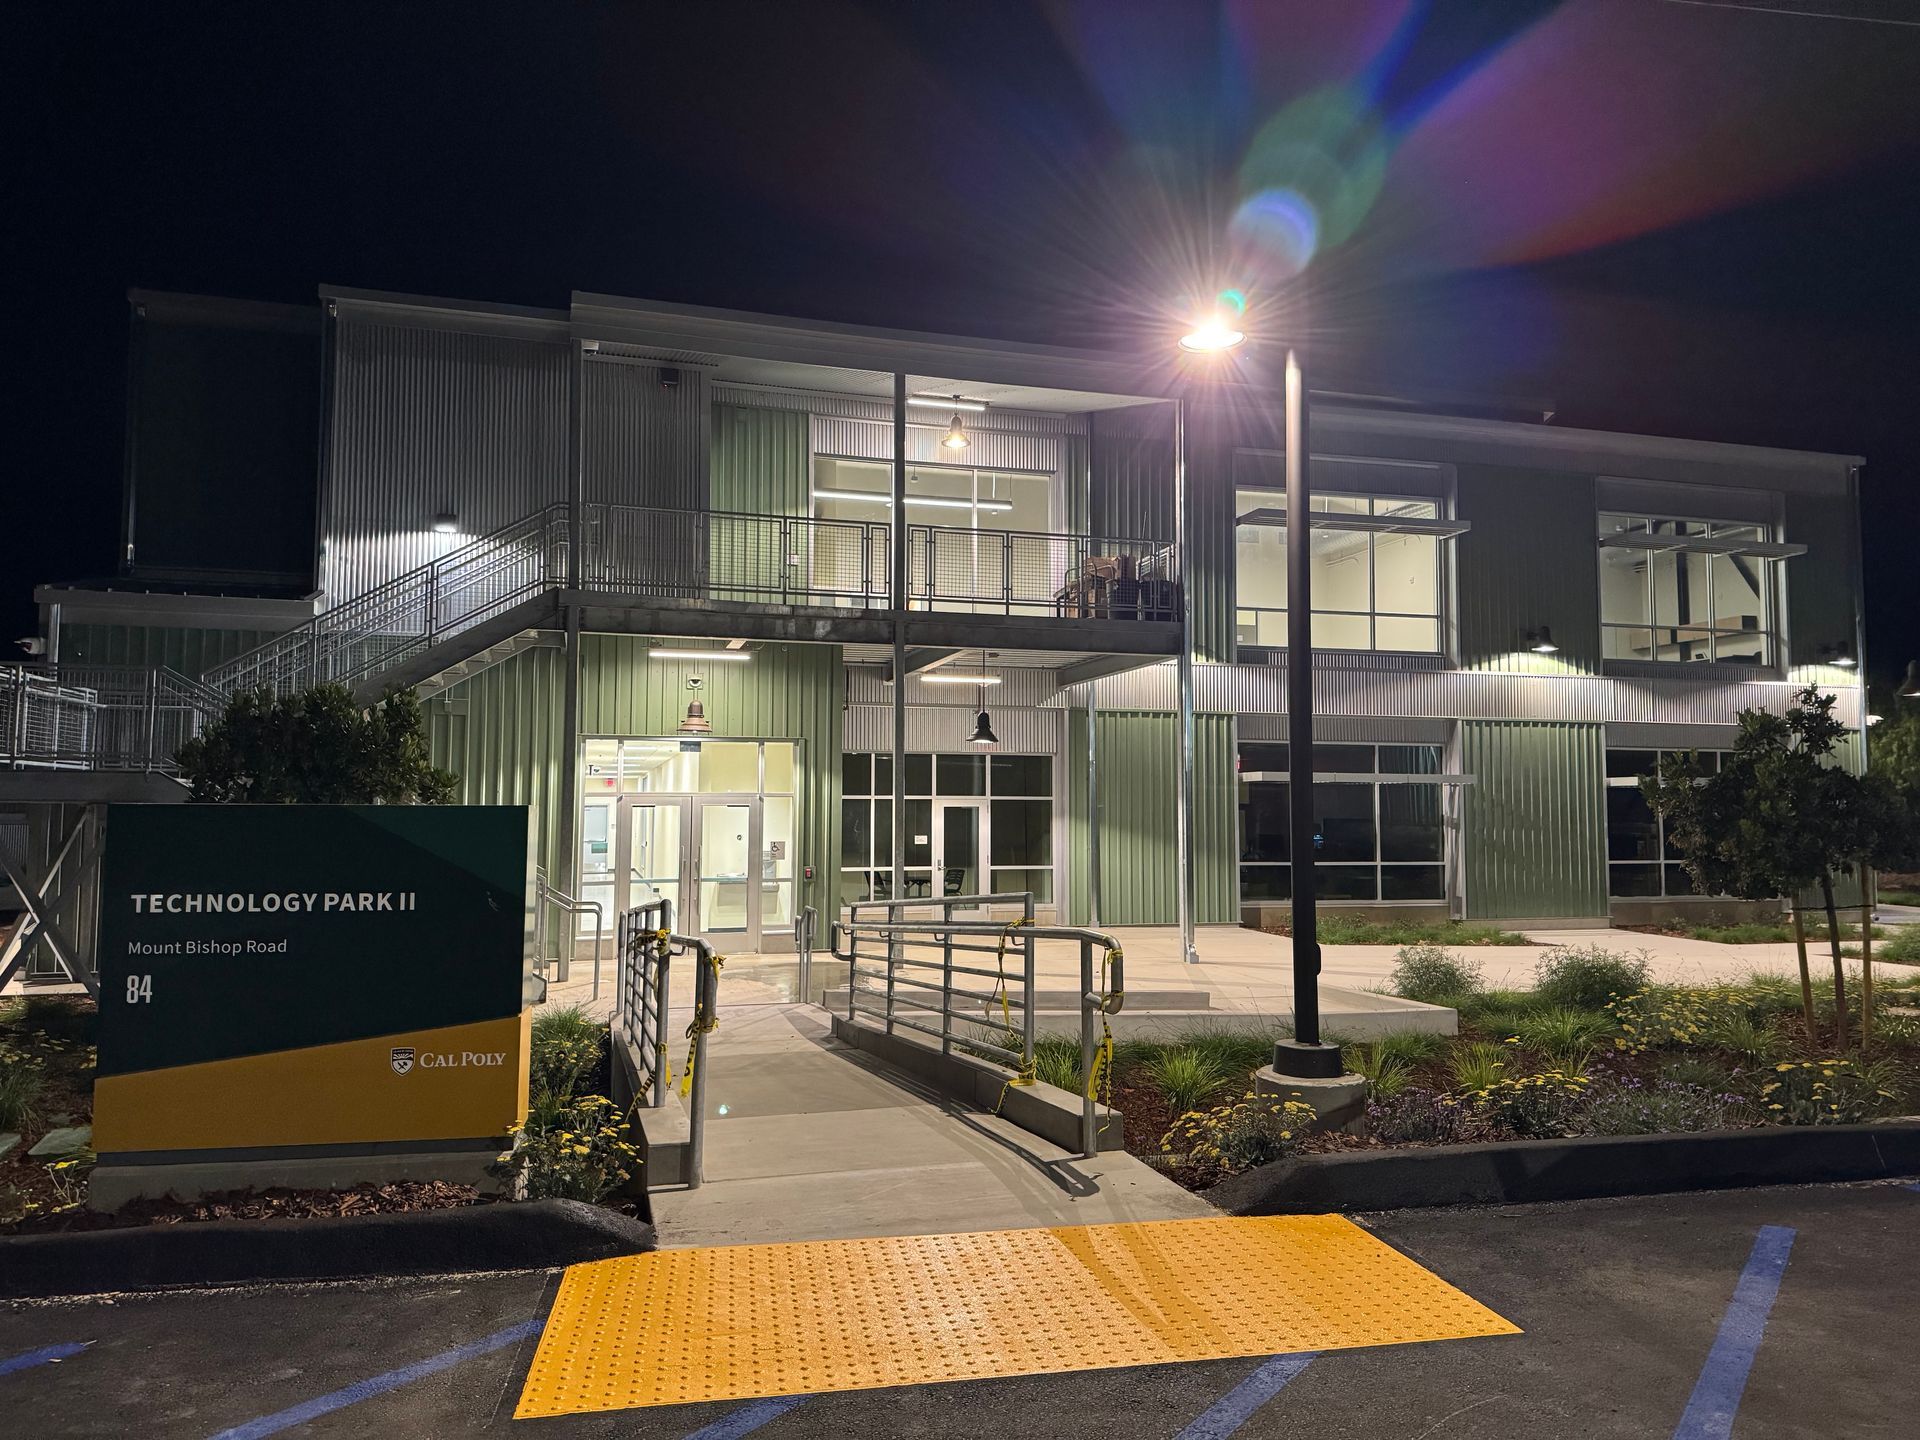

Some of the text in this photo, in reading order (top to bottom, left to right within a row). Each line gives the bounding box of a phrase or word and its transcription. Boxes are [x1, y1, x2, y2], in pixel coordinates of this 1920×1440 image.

[130, 892, 416, 914] TECHNOLOGY PARK II
[128, 938, 288, 957] Mount Bishop Road
[126, 974, 153, 1004] 84
[419, 1051, 507, 1068] CAL POLY
